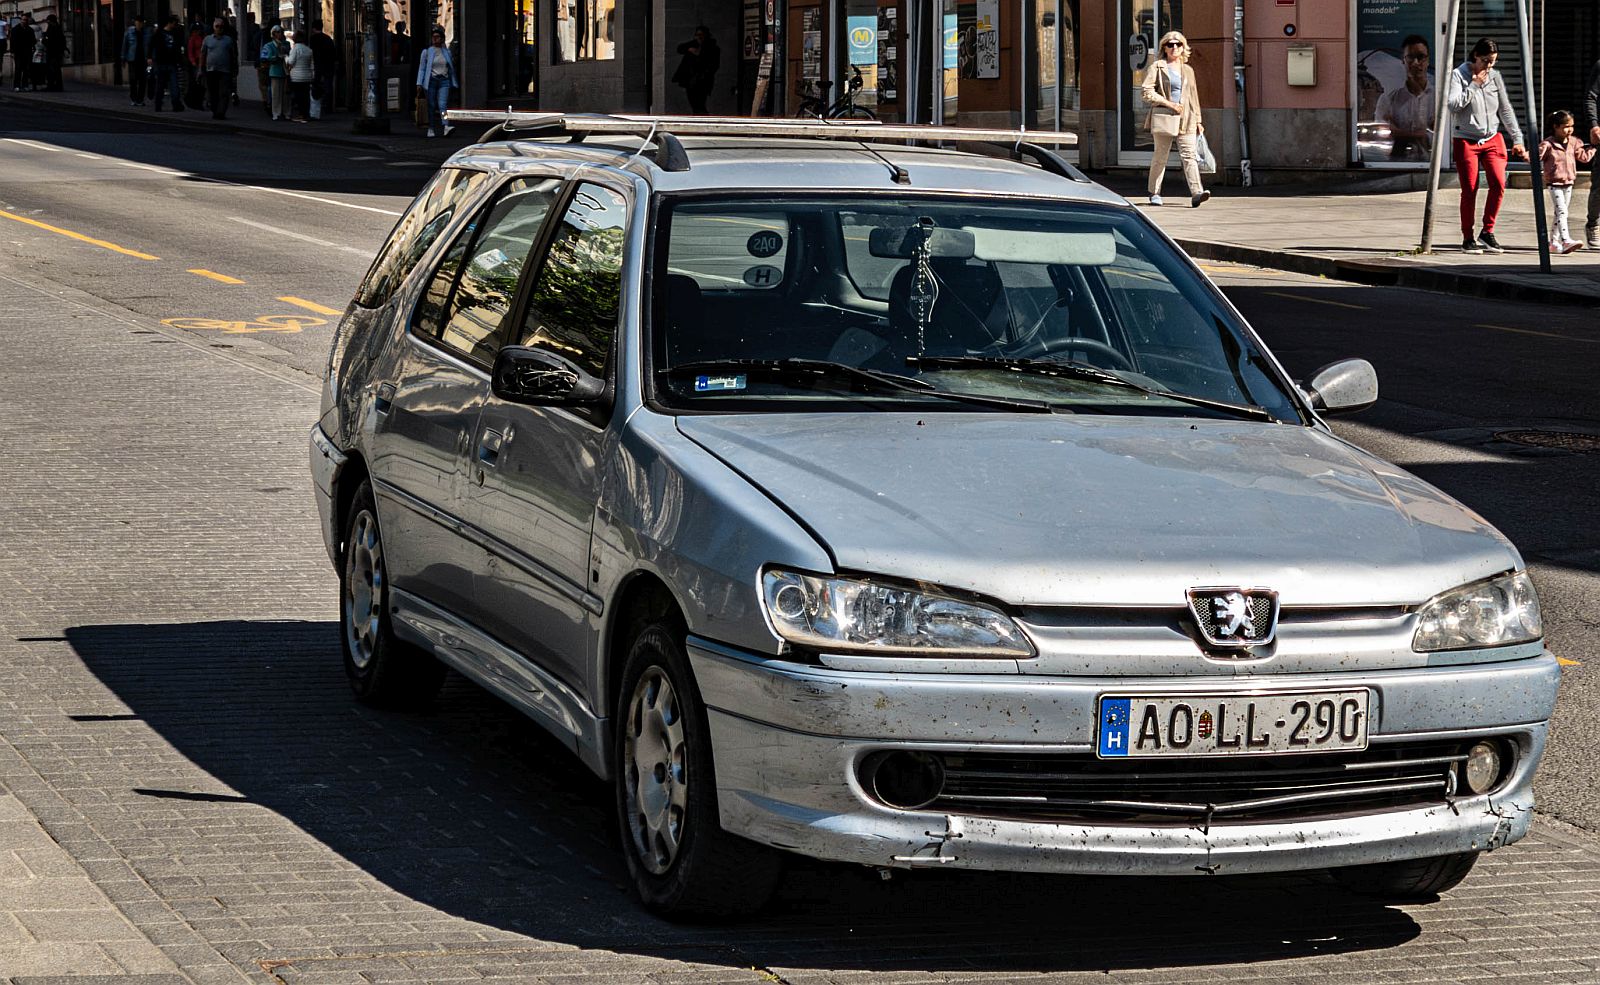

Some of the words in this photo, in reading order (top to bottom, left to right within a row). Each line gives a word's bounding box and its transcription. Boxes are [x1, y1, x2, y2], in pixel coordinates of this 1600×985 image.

[1107, 731, 1121, 749] H
[1136, 703, 1193, 750] AO
[1217, 699, 1360, 748] LL-290
